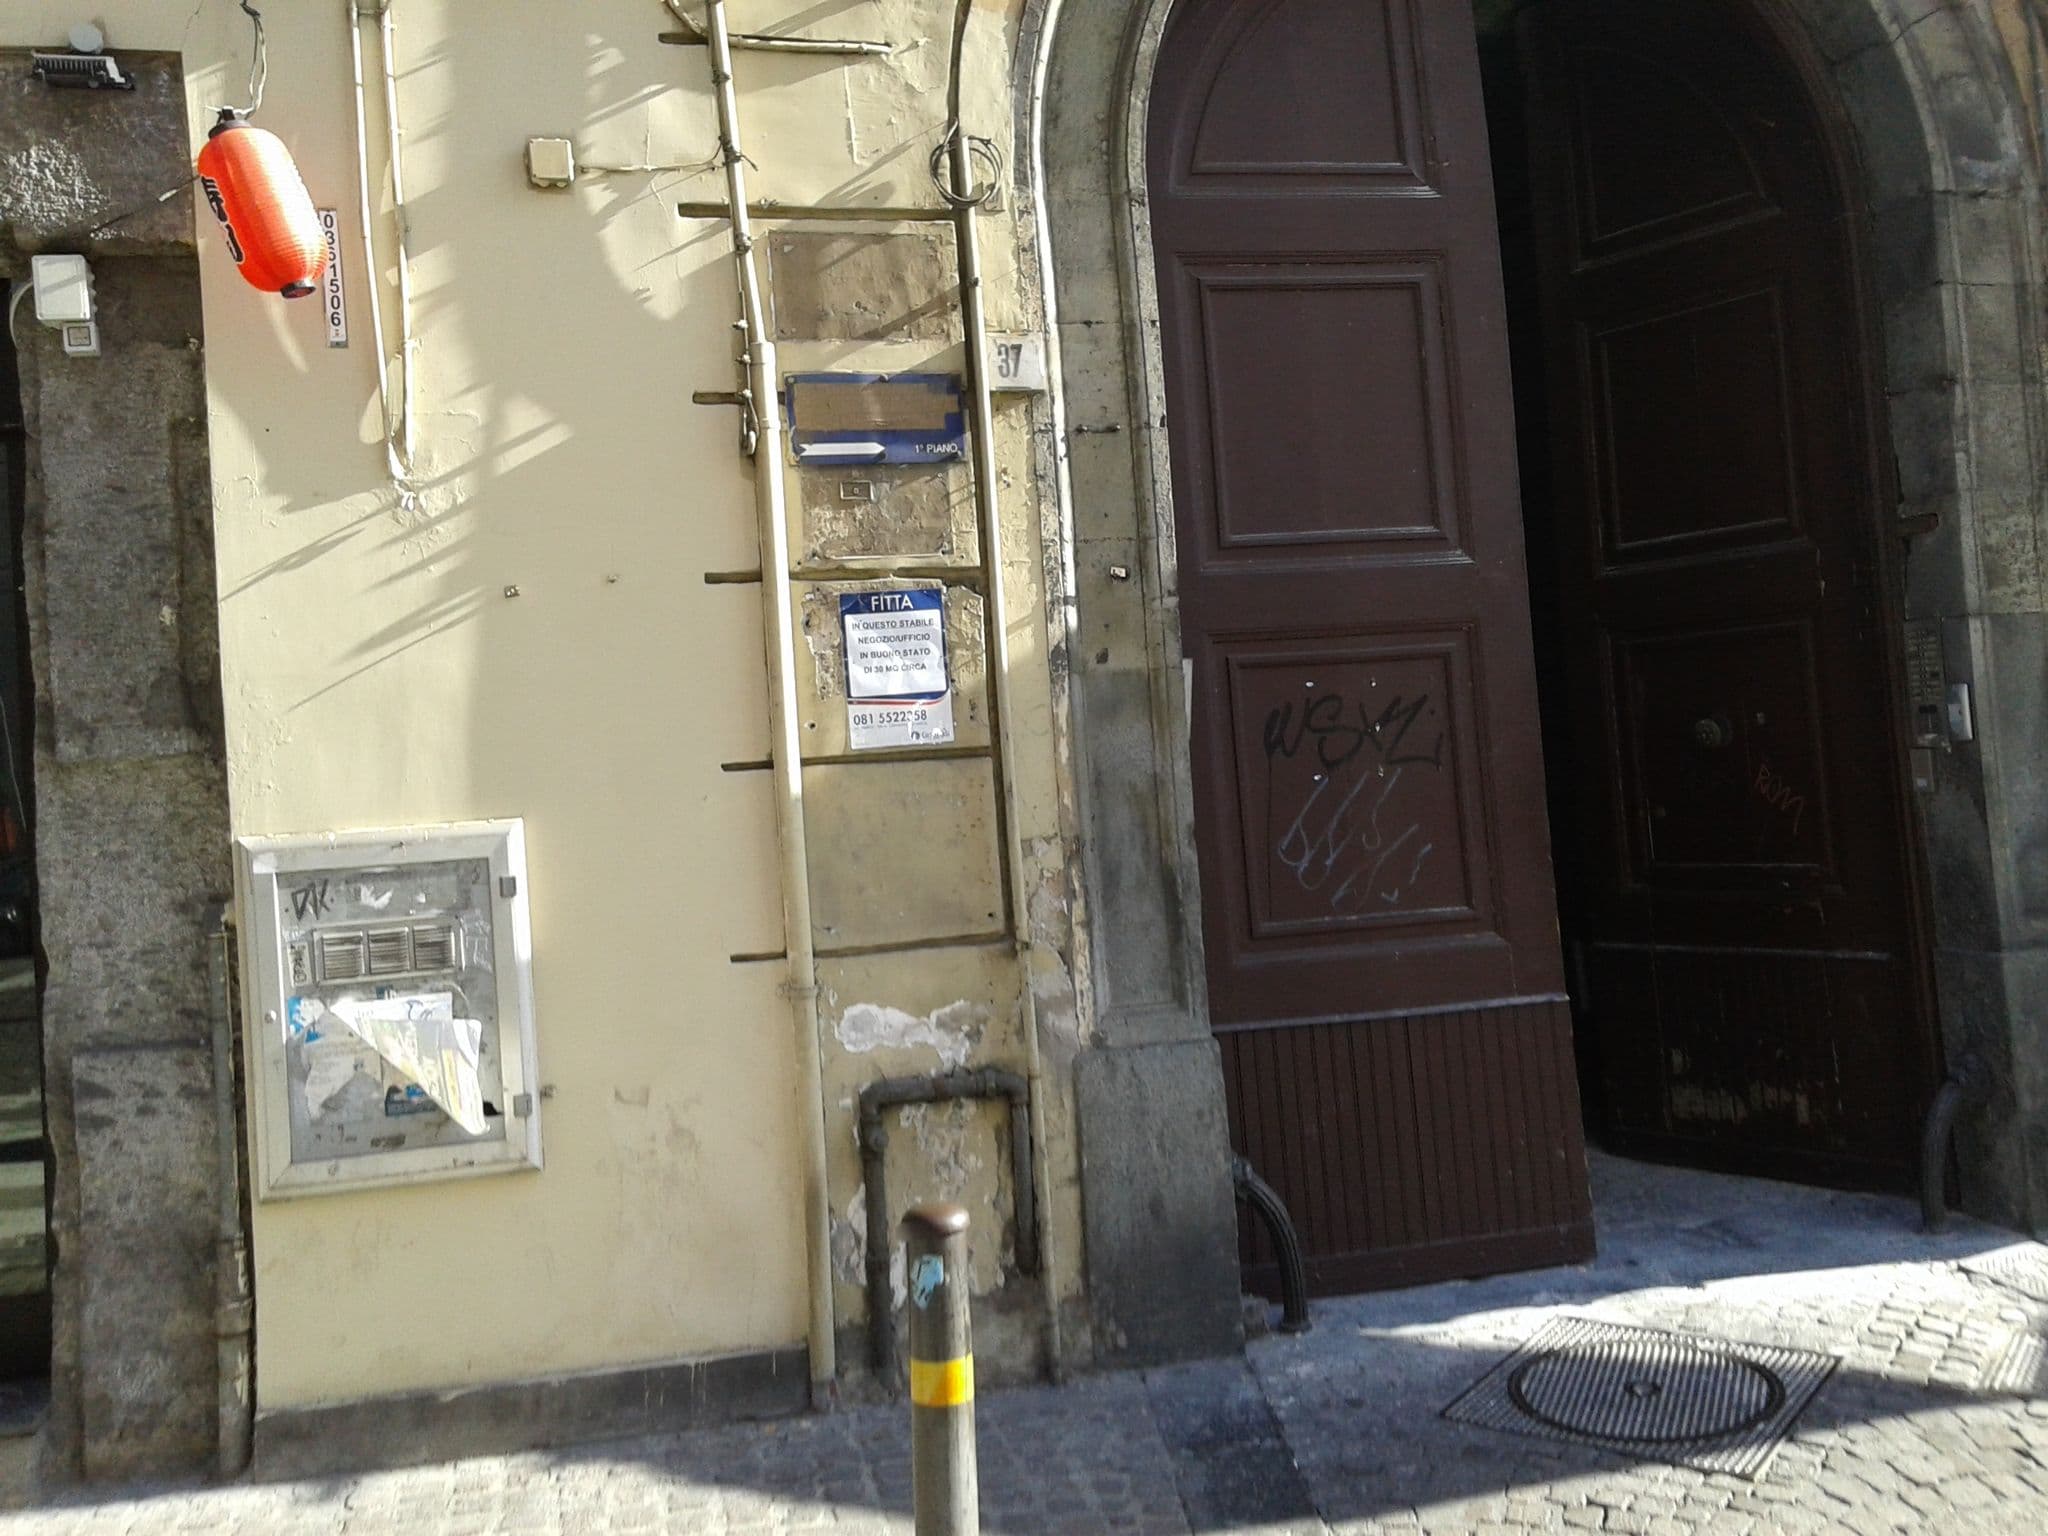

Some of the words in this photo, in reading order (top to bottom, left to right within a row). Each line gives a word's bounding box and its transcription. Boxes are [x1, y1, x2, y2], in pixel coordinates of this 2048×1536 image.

[997, 343, 1022, 378] 37
[927, 443, 958, 453] PIANO
[871, 594, 914, 611] FITTA
[852, 623, 860, 631] IN
[862, 620, 897, 629] QUESTO
[899, 618, 934, 628] STABILE
[860, 651, 868, 659] IN
[903, 648, 931, 657] STATO
[864, 665, 872, 673] DI
[853, 713, 873, 725] 081
